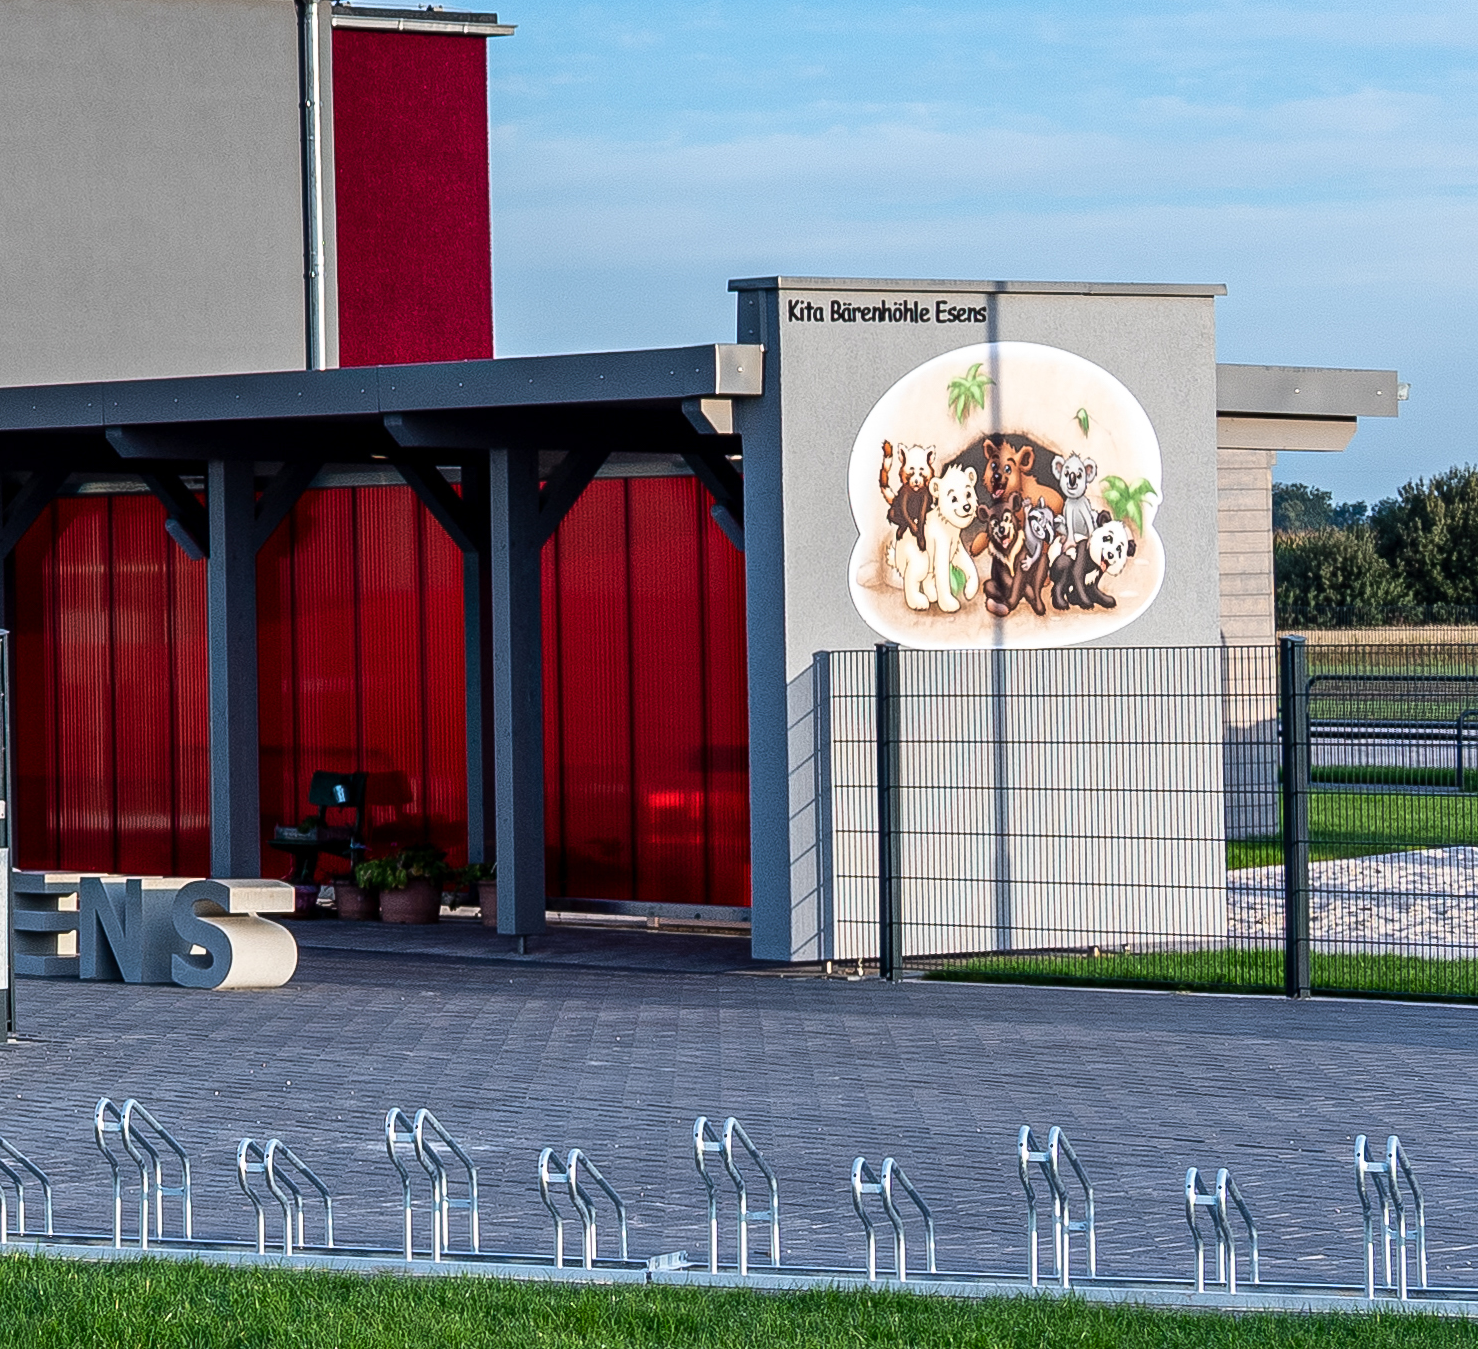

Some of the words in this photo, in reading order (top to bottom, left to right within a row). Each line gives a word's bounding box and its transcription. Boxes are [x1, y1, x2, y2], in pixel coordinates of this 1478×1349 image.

[787, 299, 825, 323] Kita
[829, 298, 931, 324] Bärenhöhle
[934, 299, 987, 324] Esens
